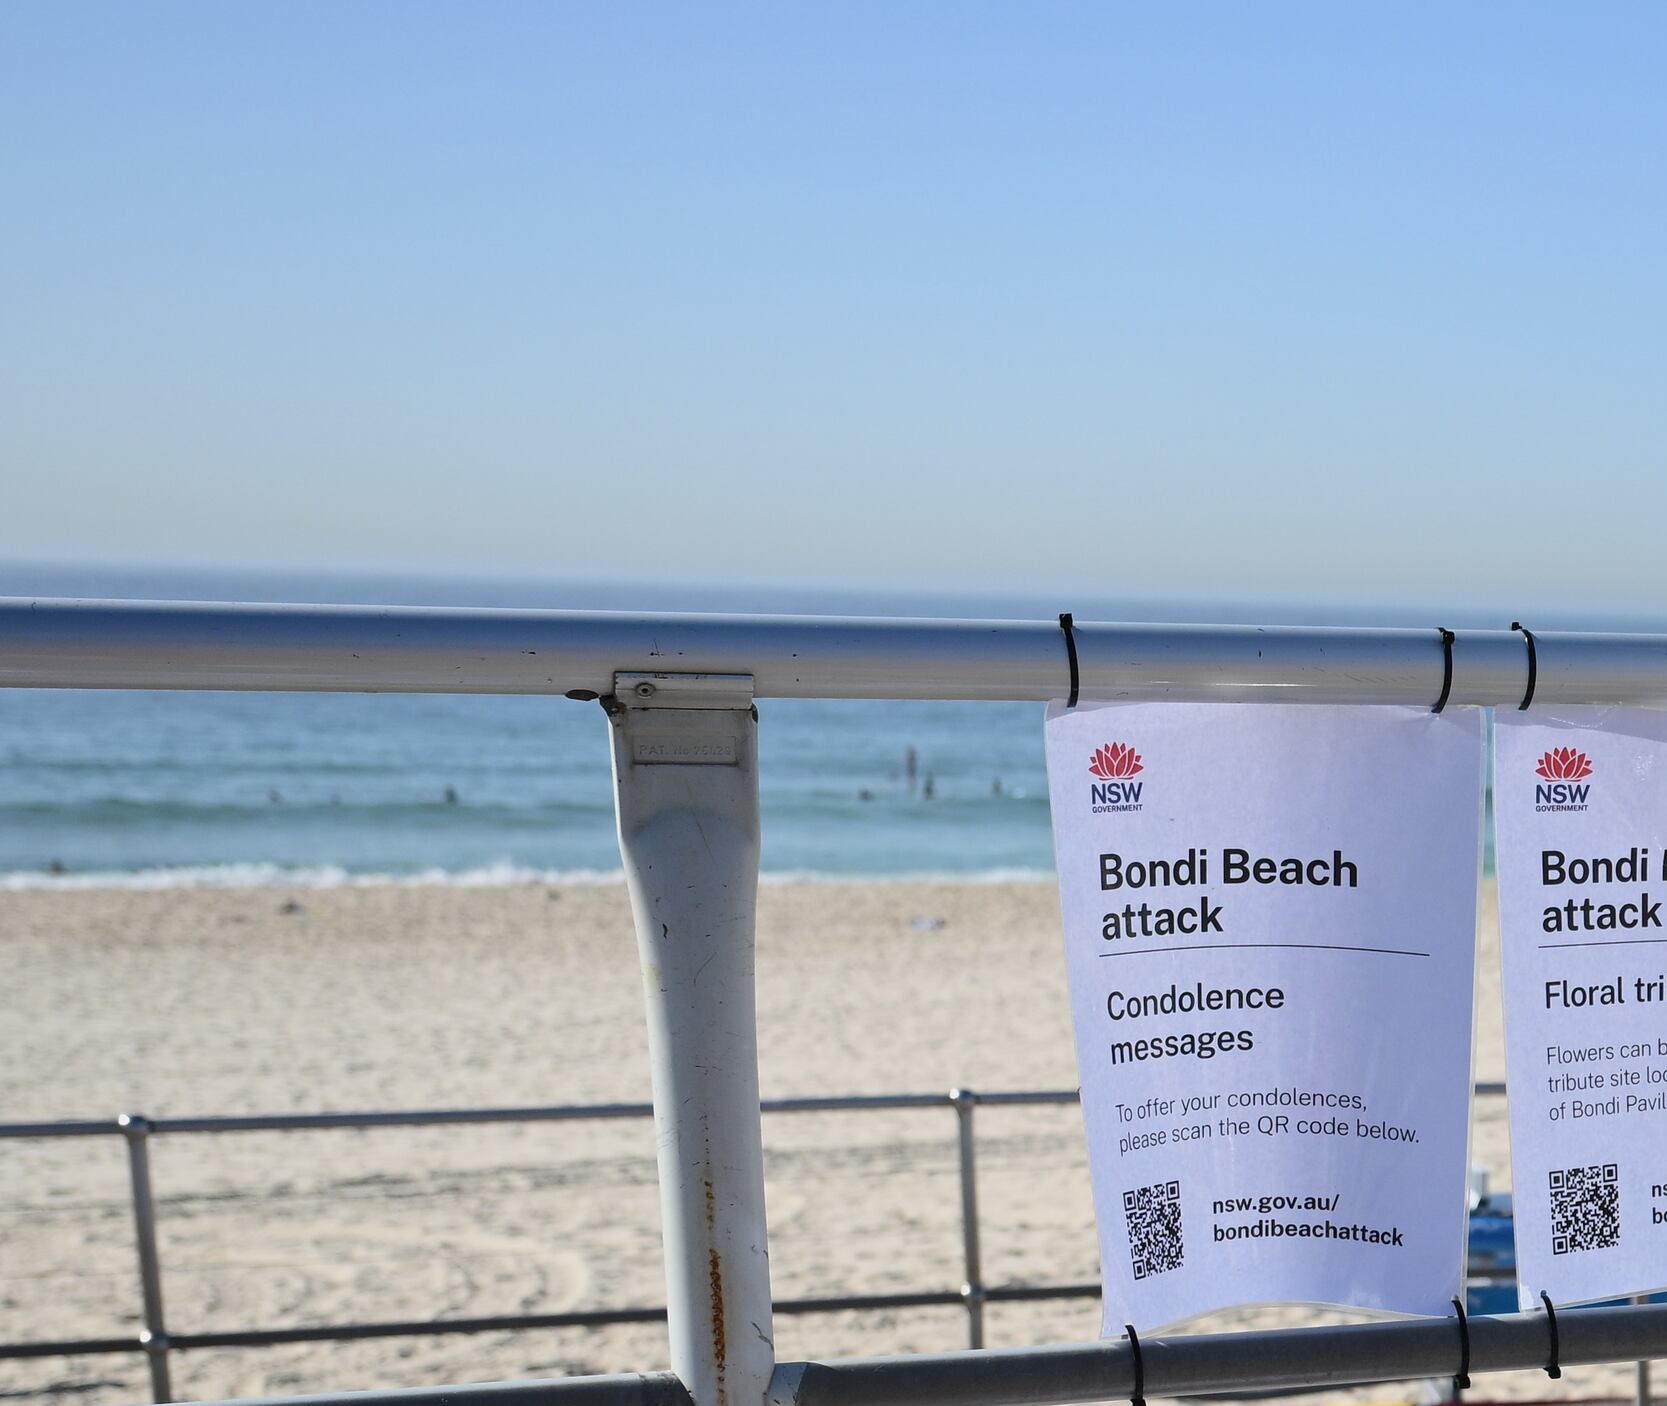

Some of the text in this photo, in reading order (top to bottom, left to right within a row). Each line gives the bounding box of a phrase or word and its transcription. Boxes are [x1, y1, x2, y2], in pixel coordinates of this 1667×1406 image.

[1091, 782, 1143, 804] NSW
[1092, 803, 1143, 813] GOVERNMENT
[1535, 804, 1589, 812] GOVERNMENT
[1536, 784, 1590, 804] NSW
[1099, 848, 1357, 891] Bondi Beach
[1542, 847, 1648, 885] Bondi
[1102, 896, 1224, 943] attack
[1543, 893, 1663, 934] attack
[1107, 982, 1284, 1021] Condolence
[1545, 976, 1625, 1009] Floral
[1111, 1030, 1254, 1065] messages
[1547, 1046, 1617, 1065] Flowers
[1619, 1044, 1651, 1058] can
[1548, 1072, 1605, 1092] tribute
[1610, 1066, 1640, 1087] site
[1116, 1088, 1366, 1122] To offer your condolences,
[1549, 1099, 1566, 1121] of
[1572, 1097, 1620, 1118] Bondi
[1120, 1115, 1419, 1157] please scan the QR code below.
[1213, 1194, 1340, 1217] nsw.gov.au/
[1214, 1217, 1403, 1247] bondibeachattack
